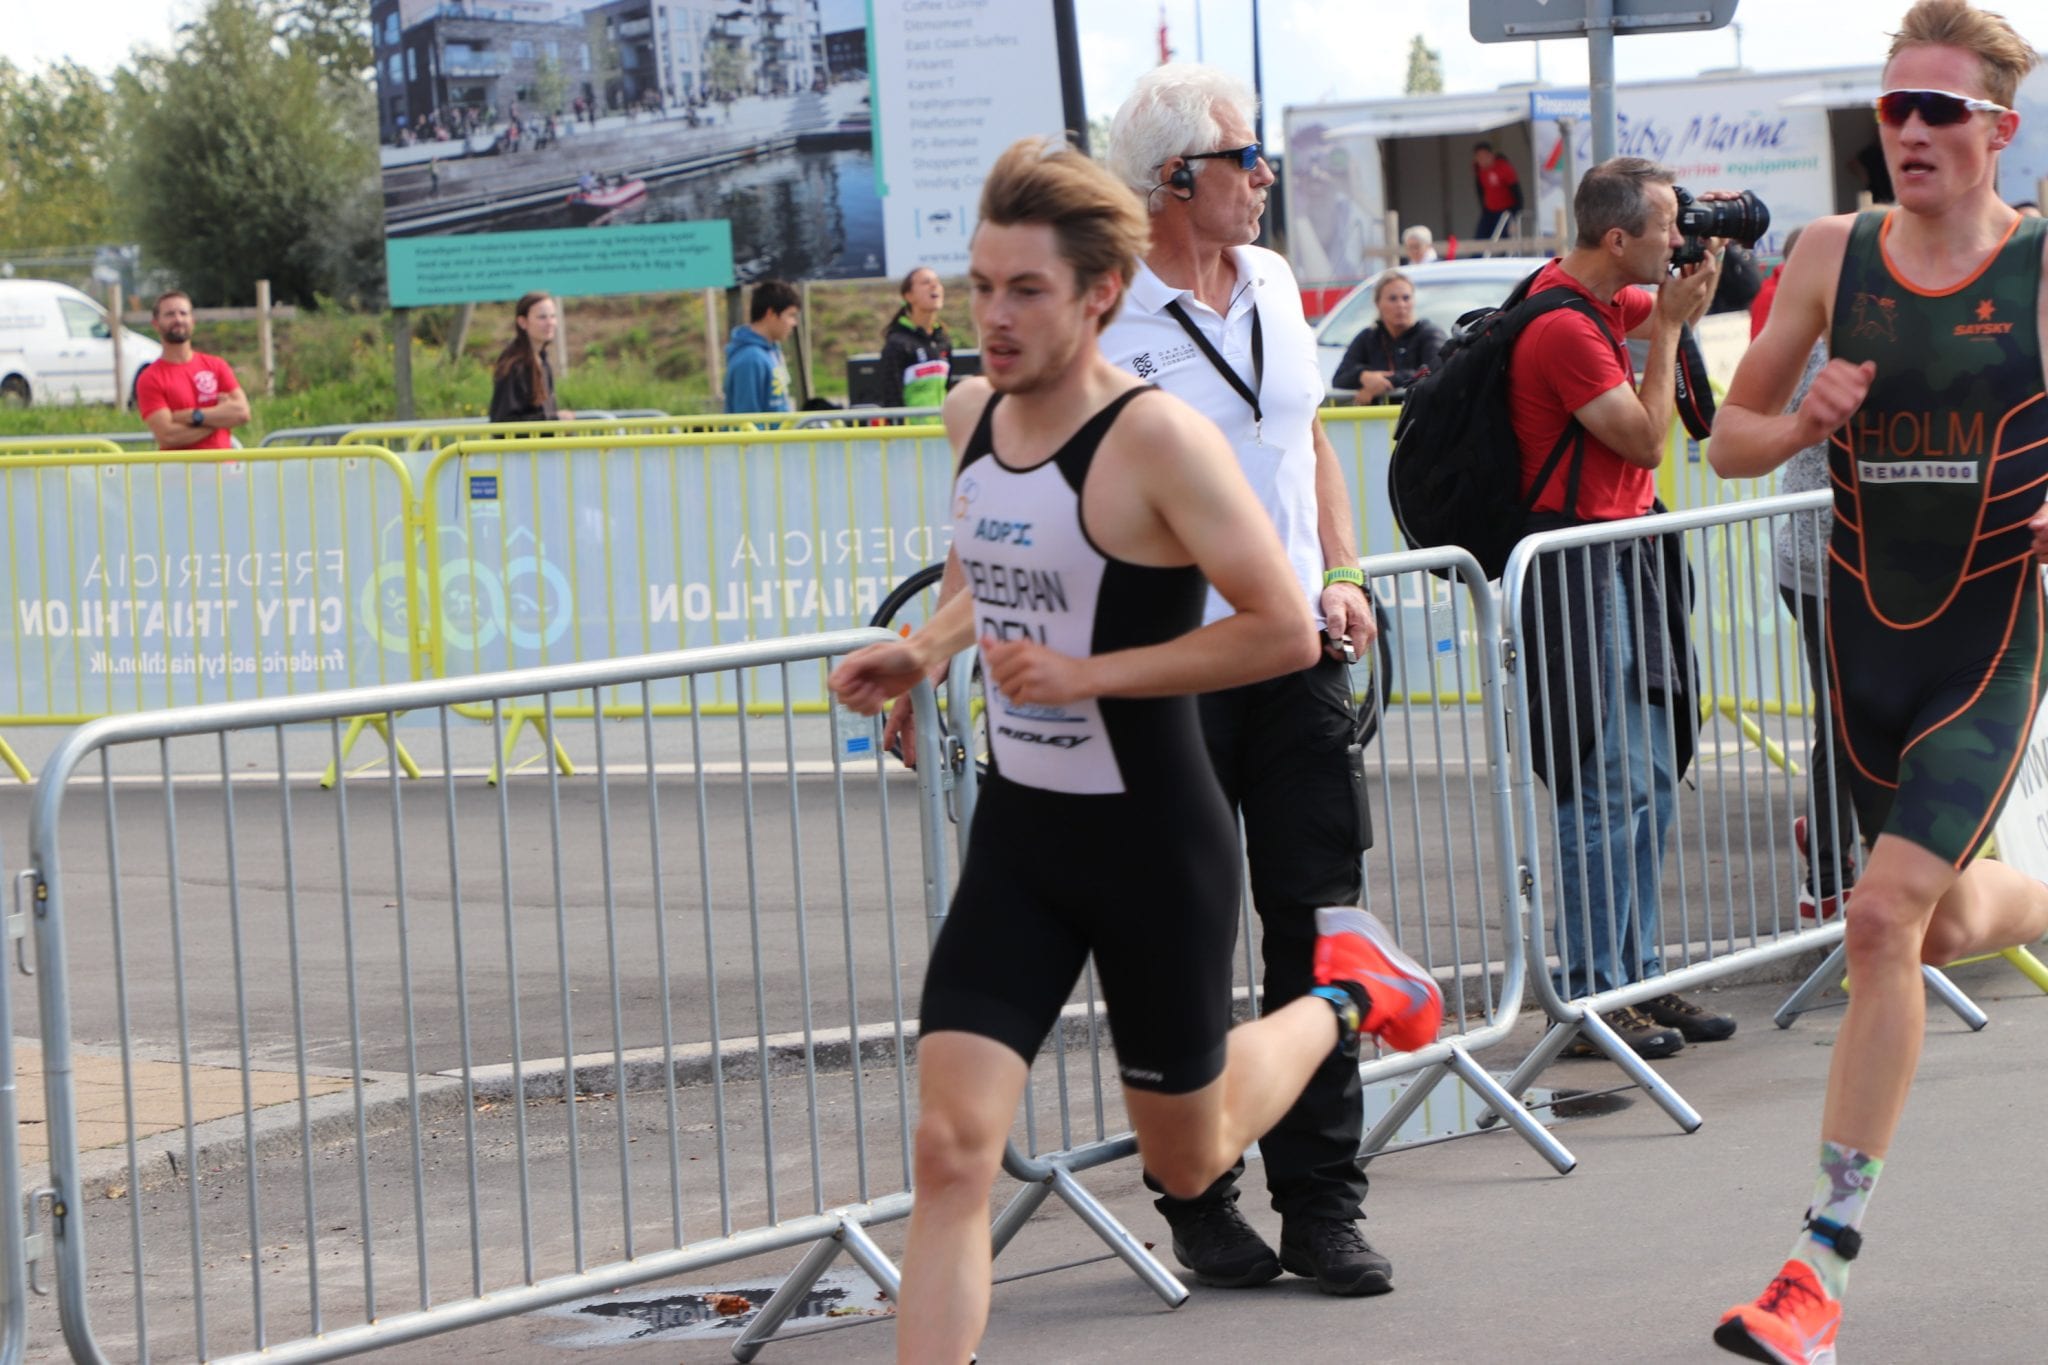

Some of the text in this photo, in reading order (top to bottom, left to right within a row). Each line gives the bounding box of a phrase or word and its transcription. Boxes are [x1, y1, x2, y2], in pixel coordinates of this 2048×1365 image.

[1726, 155, 1820, 176] equipment
[1858, 411, 1985, 457] HOLM
[963, 559, 1069, 613] ELEURAN
